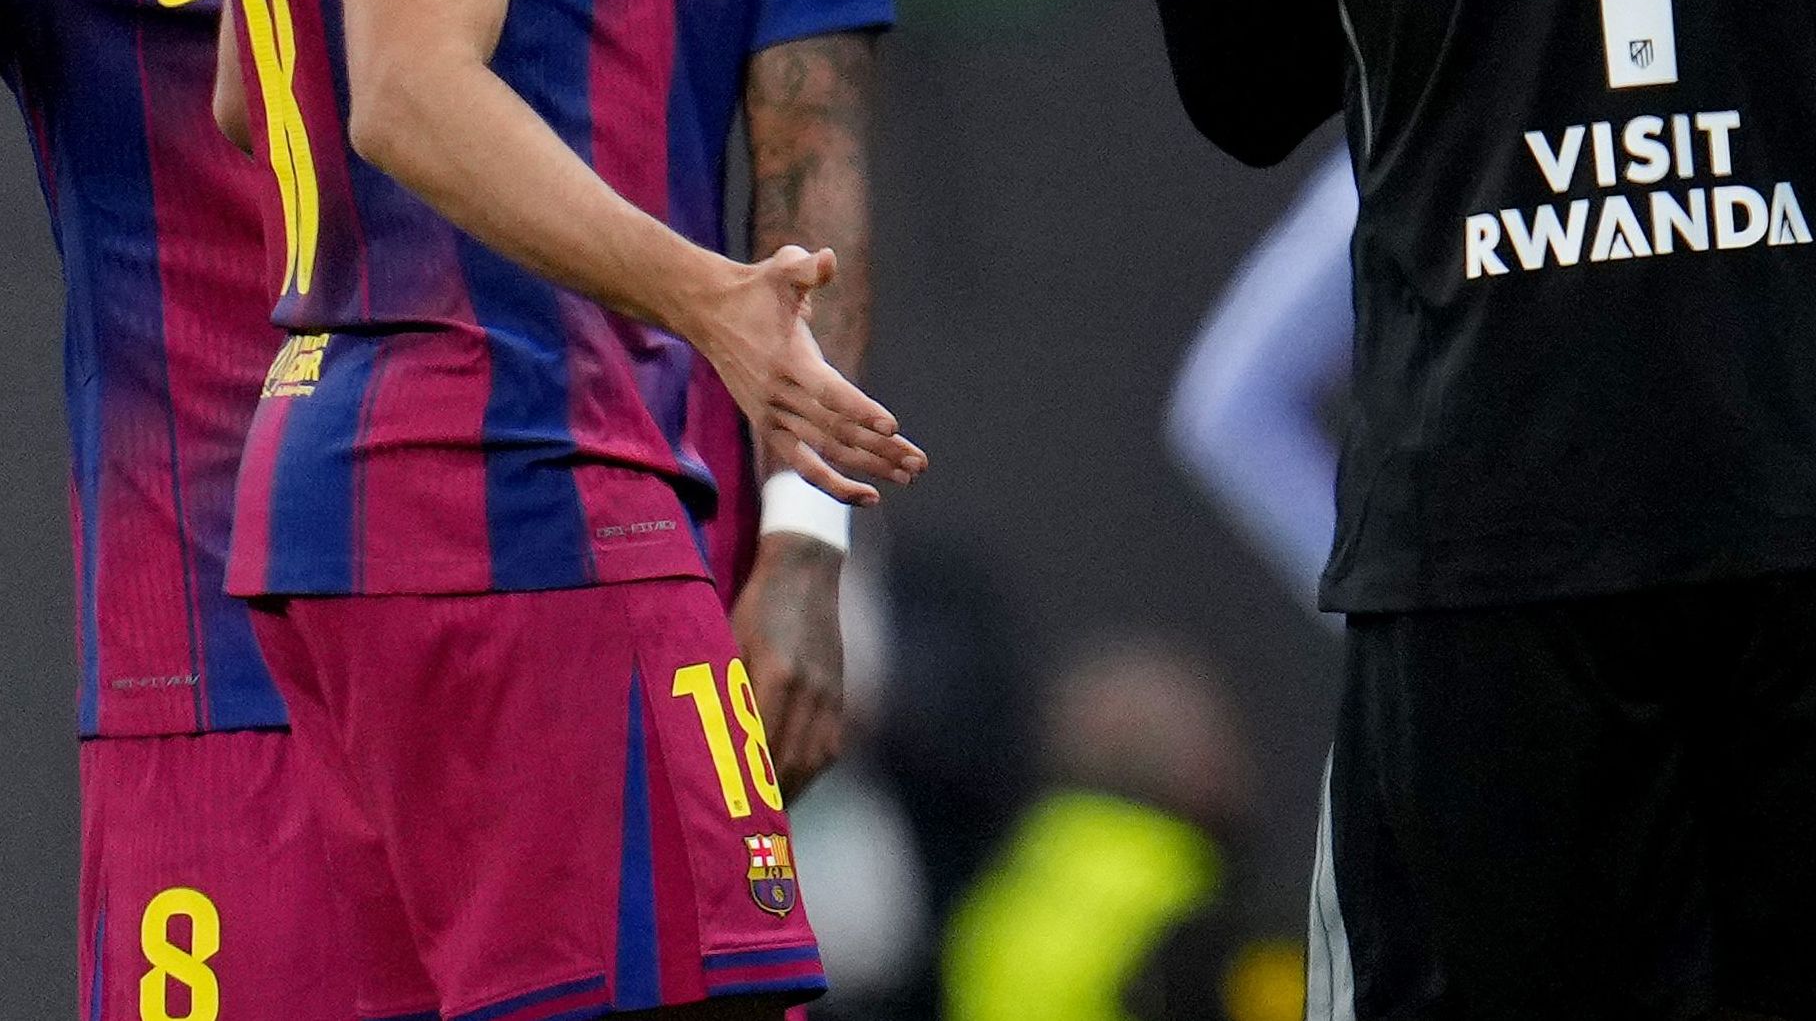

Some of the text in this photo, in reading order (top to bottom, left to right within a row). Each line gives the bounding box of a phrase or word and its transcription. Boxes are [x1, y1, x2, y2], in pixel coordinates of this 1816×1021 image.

[1524, 110, 1741, 193] VISIT
[1465, 181, 1813, 279] RWANDA
[672, 658, 784, 819] 18
[139, 887, 221, 1021] 8
